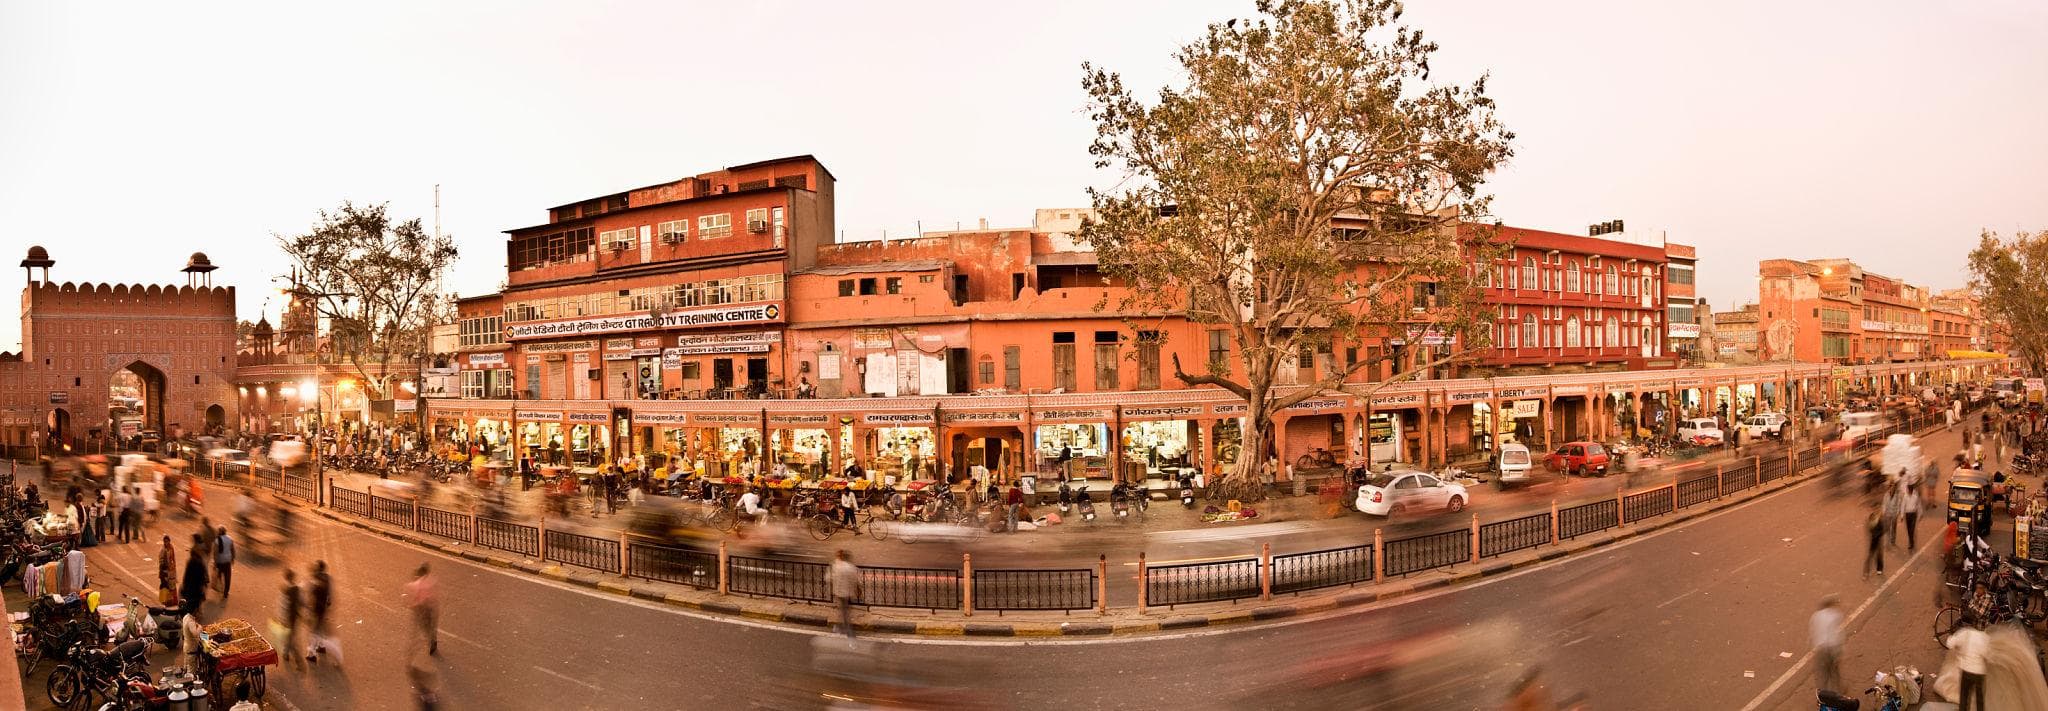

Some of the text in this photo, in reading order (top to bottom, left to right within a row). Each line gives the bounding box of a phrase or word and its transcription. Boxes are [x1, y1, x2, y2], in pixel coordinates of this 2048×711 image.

[625, 309, 763, 329] GT RADIO TV TRAINING CENTRE
[1499, 389, 1526, 398] LIBERTY
[1517, 403, 1535, 414] SALE
